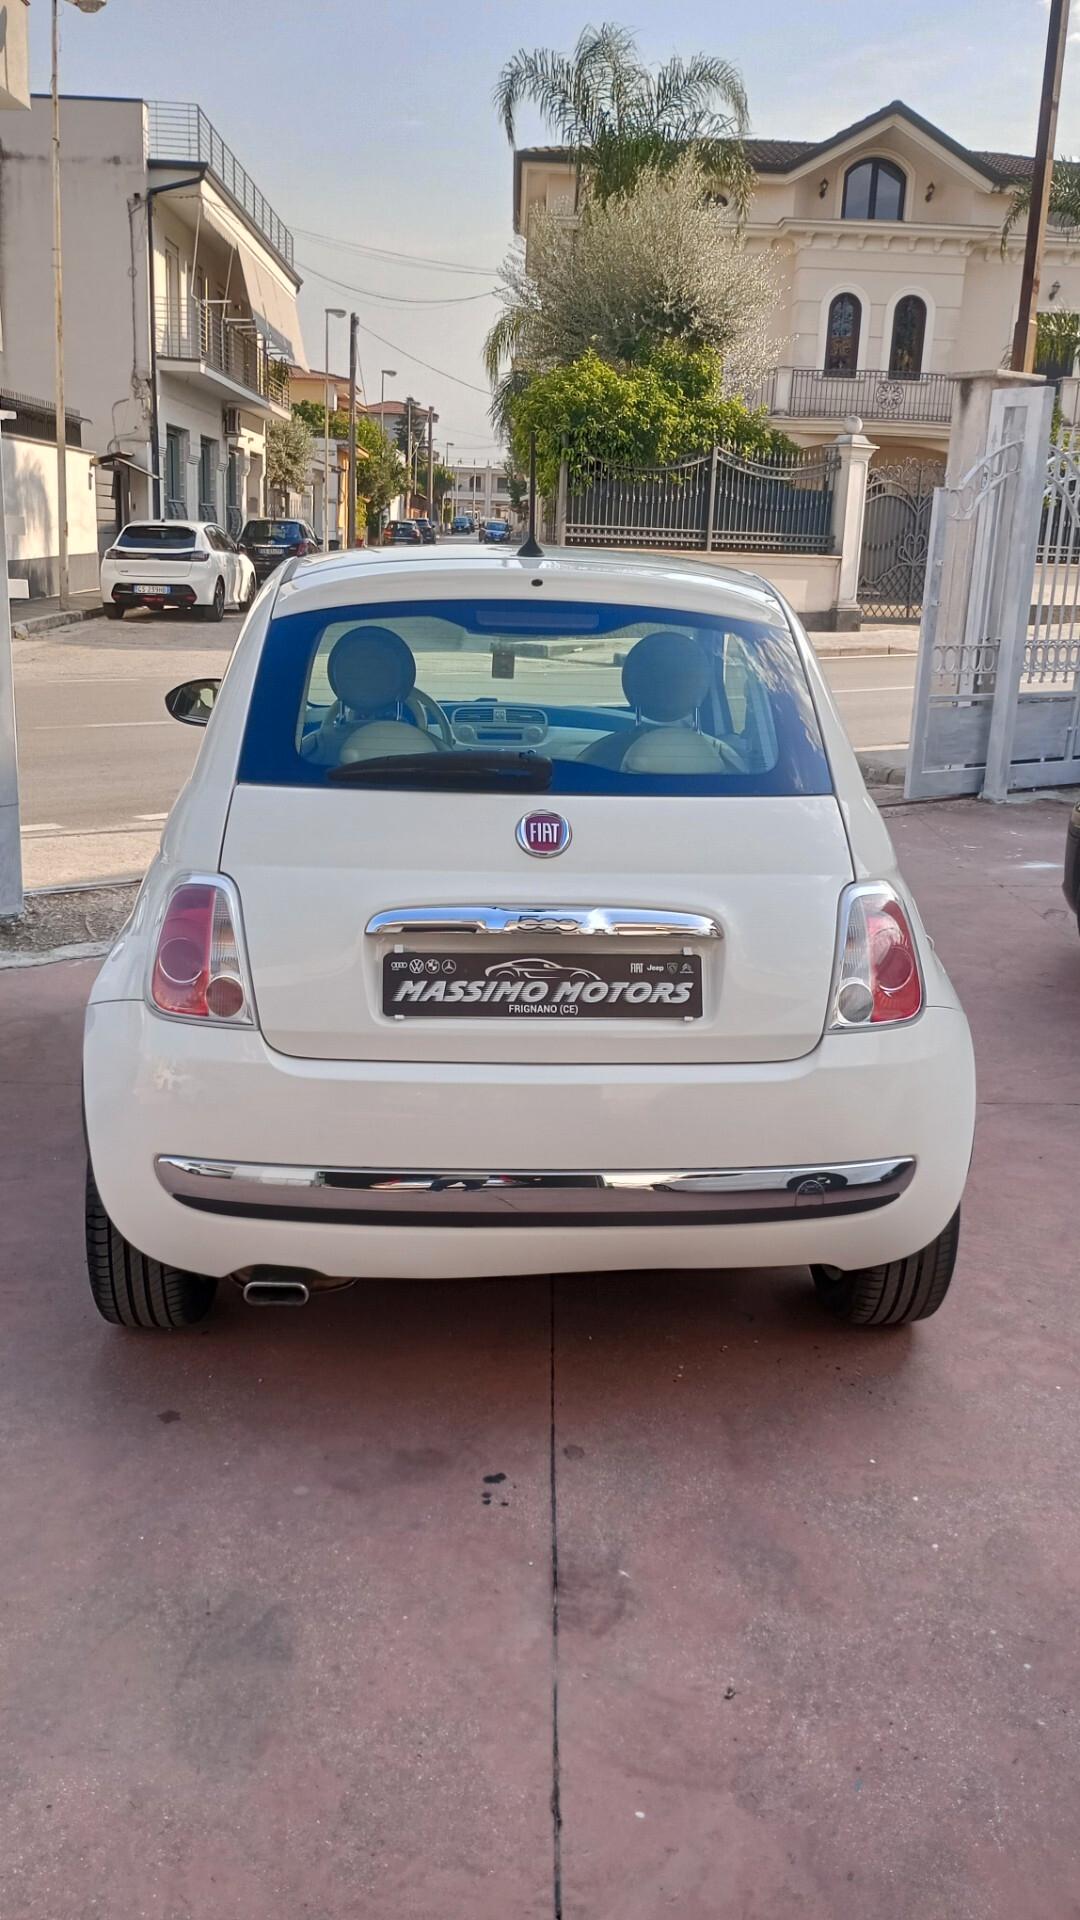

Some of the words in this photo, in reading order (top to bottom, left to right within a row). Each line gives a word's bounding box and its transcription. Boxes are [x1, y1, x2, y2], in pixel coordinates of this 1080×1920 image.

[530, 822, 560, 843] FIAT
[516, 915, 580, 932] 500
[630, 962, 643, 974] FIAT
[646, 963, 664, 973] Jeep
[392, 980, 549, 1003] MASSIMO
[551, 981, 695, 1004] MOTORS
[508, 1004, 558, 1014] FRIGNANO
[559, 1004, 579, 1015] (CE)
